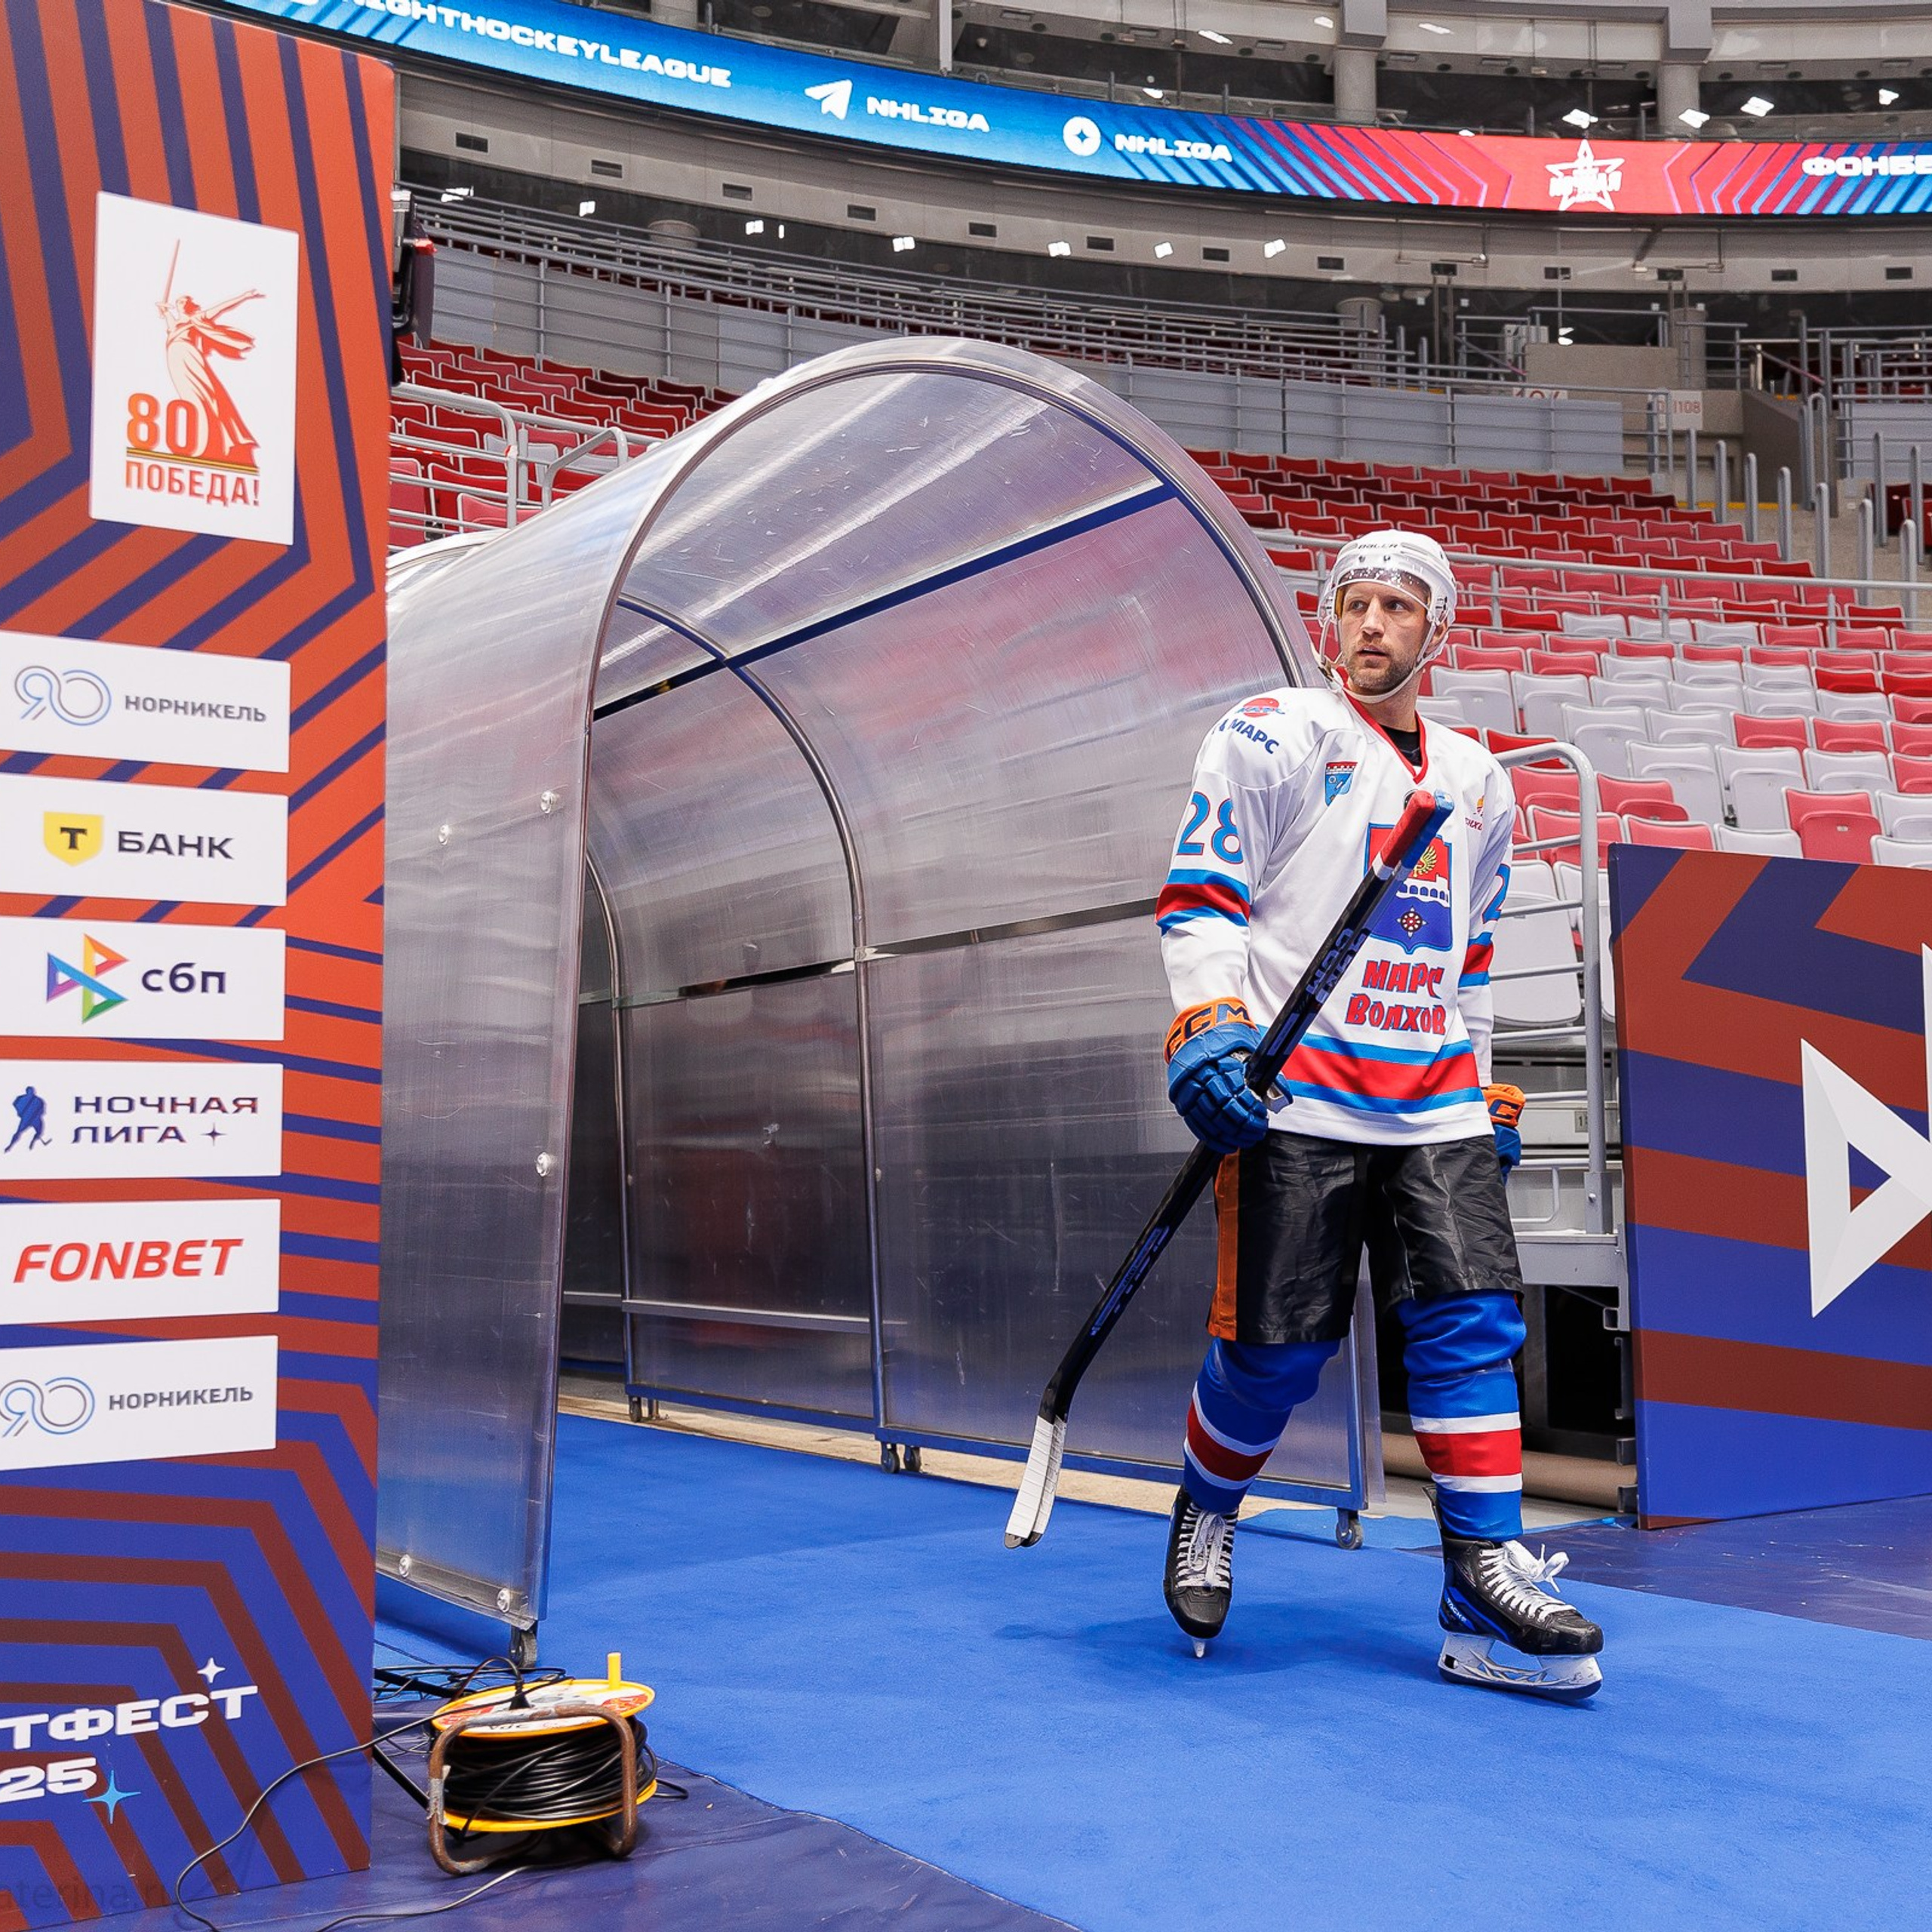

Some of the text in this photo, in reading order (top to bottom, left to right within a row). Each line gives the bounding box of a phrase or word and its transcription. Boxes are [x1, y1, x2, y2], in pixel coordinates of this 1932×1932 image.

[126, 392, 199, 457] 80
[125, 460, 260, 507] ПОБЕДА!
[124, 694, 266, 722] НОРНИКЕЛЬ
[118, 830, 234, 860] БАНК
[1176, 790, 1244, 864] 28
[141, 962, 226, 994] сбп
[1361, 959, 1445, 1000] МАРС
[1166, 1003, 1251, 1060] CCM
[74, 1096, 258, 1114] НОЧНАЯ
[71, 1125, 187, 1144] ЛИГА
[13, 1238, 245, 1283] FONBET
[108, 1386, 254, 1411] НОРНИКЕЛЬ
[0, 1684, 258, 1750] ТФЕСТ
[0, 1757, 97, 1804] 25
